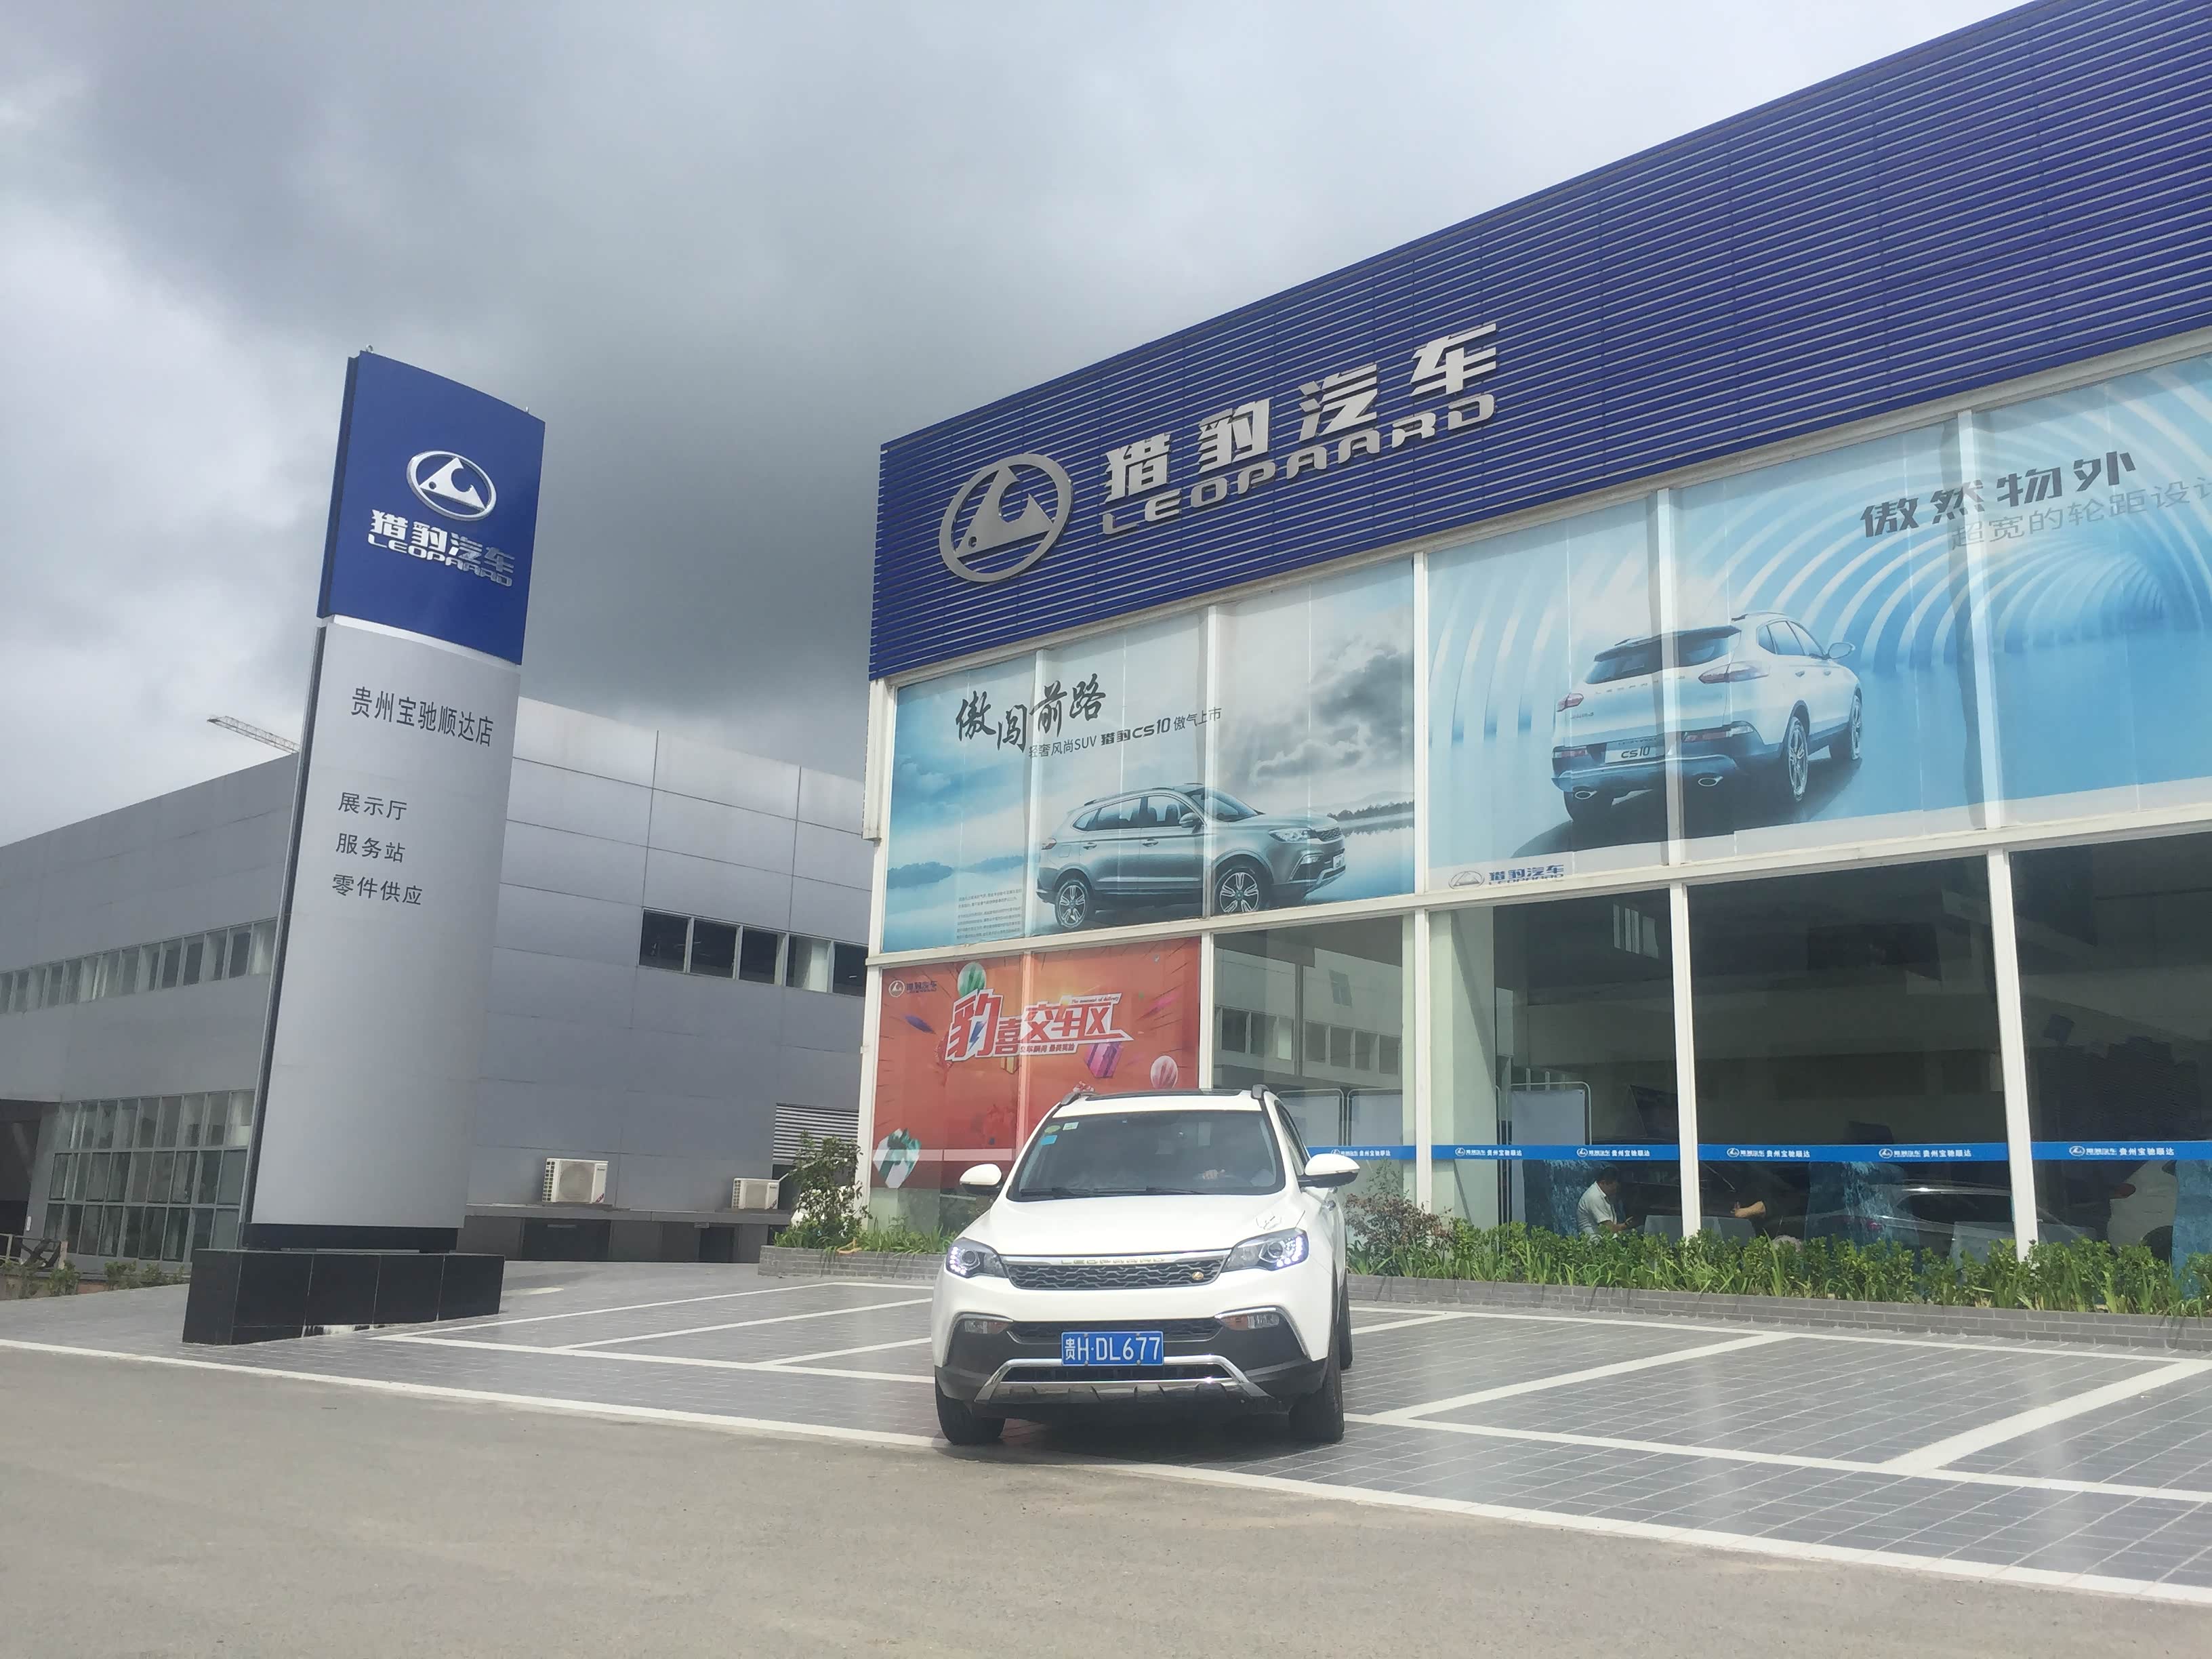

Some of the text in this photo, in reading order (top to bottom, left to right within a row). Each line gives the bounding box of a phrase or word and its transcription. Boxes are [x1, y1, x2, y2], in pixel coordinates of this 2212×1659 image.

[1104, 323, 1496, 504] 猎豹汽车
[1102, 392, 1495, 535] LEOPAARD
[1860, 451, 2137, 537] 傲然物外
[368, 533, 513, 587] LEOPAARD
[369, 509, 516, 574] 猎豹汽车
[350, 687, 495, 747] 贵州宝驰顺达店
[956, 673, 1106, 753] 傲闯前路
[1029, 735, 1097, 758] 轻奢风尚SUV
[1173, 707, 1222, 731] 傲气上市
[1620, 746, 1650, 758] CS10
[337, 792, 407, 821] 展示厅
[335, 833, 406, 863] 服务站
[332, 874, 424, 905] 零件供应
[1065, 1337, 1160, 1361] 贵H·DL677
